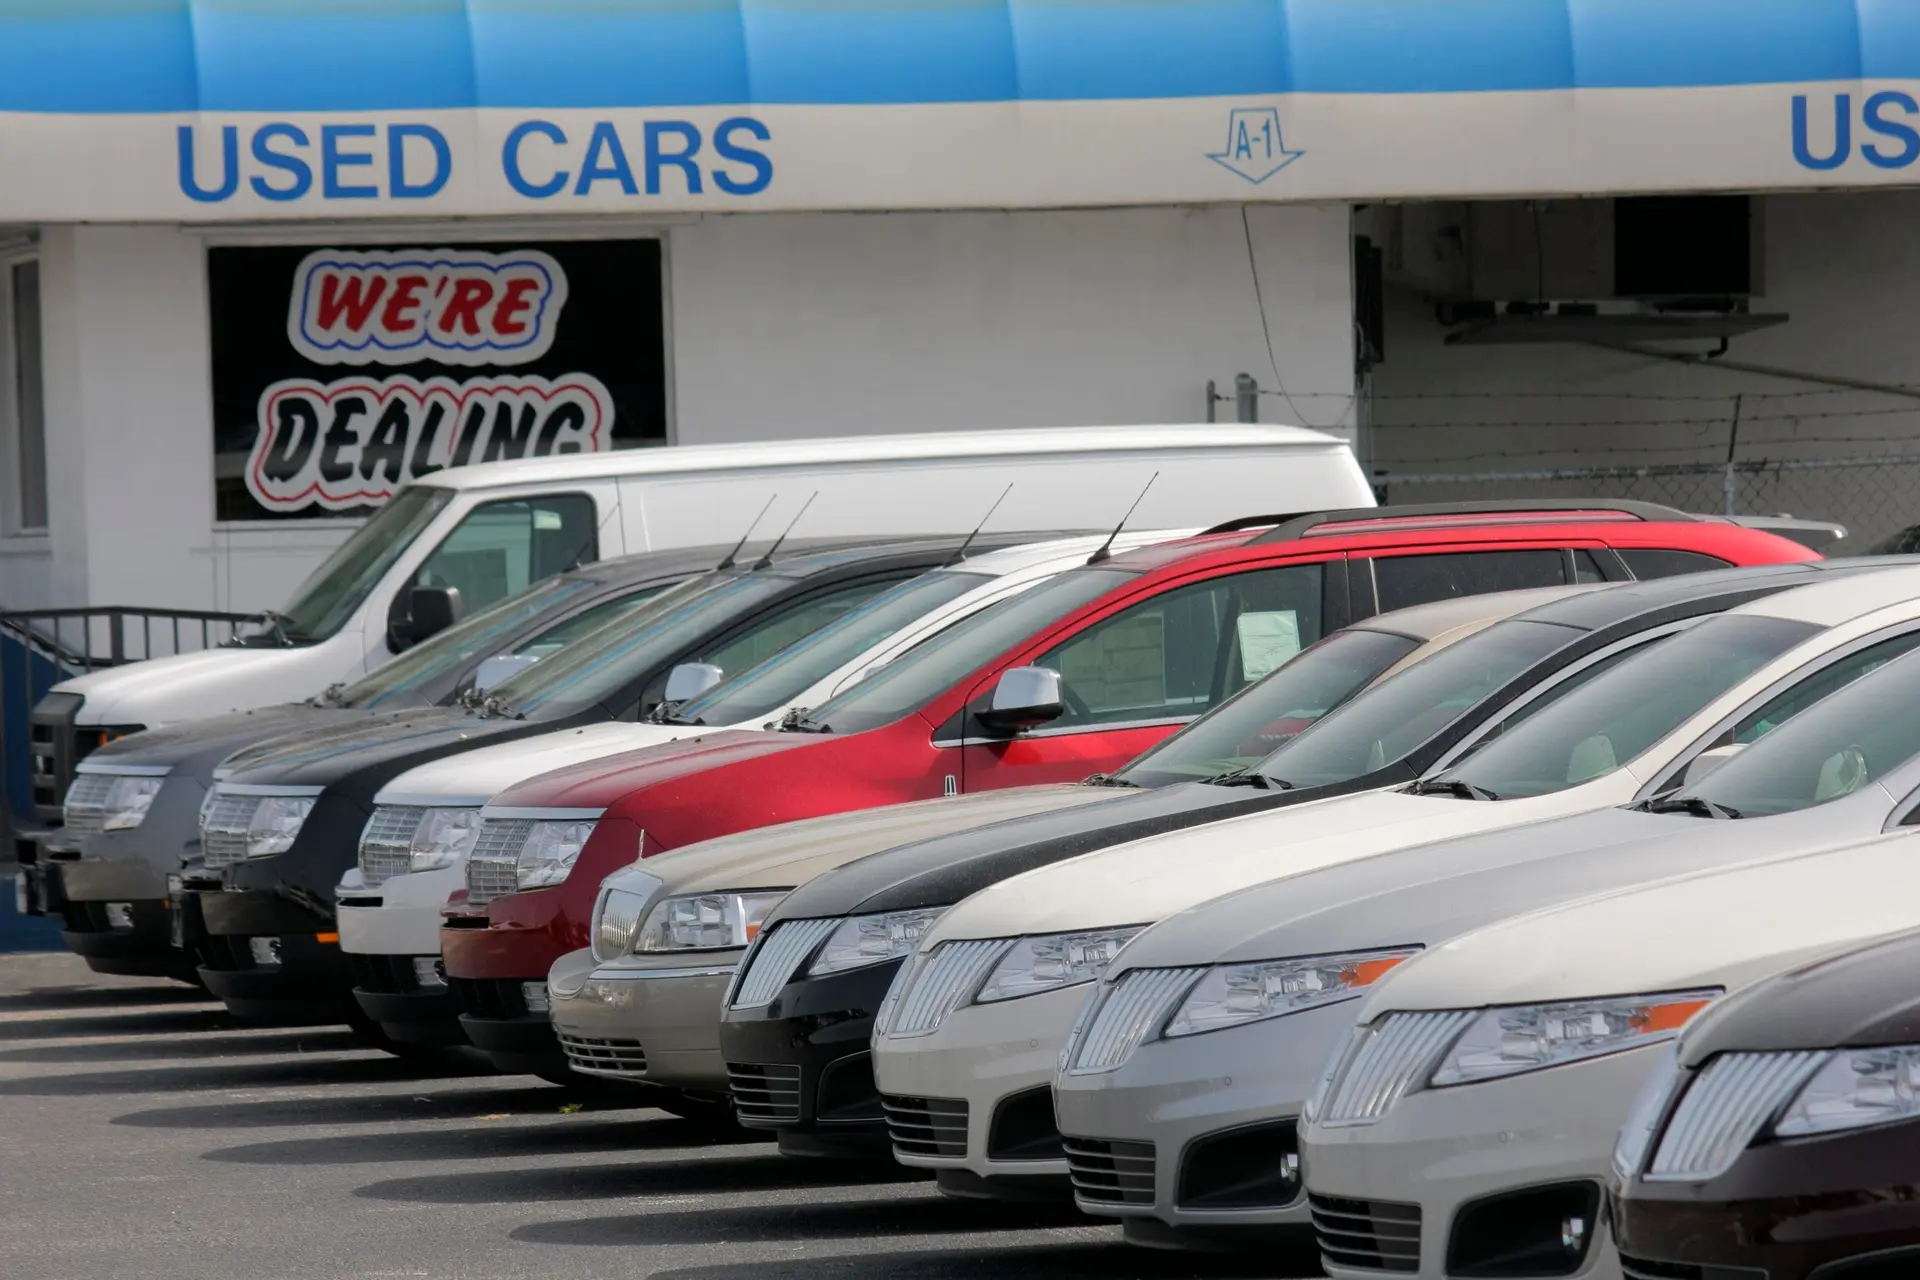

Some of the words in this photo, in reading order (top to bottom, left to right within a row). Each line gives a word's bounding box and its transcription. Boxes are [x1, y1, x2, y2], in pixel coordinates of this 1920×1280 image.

[177, 122, 452, 203] USED
[502, 117, 773, 199] CARS
[1235, 118, 1272, 161] A-1
[317, 273, 539, 335] WE'RE
[262, 396, 585, 484] DEALING
